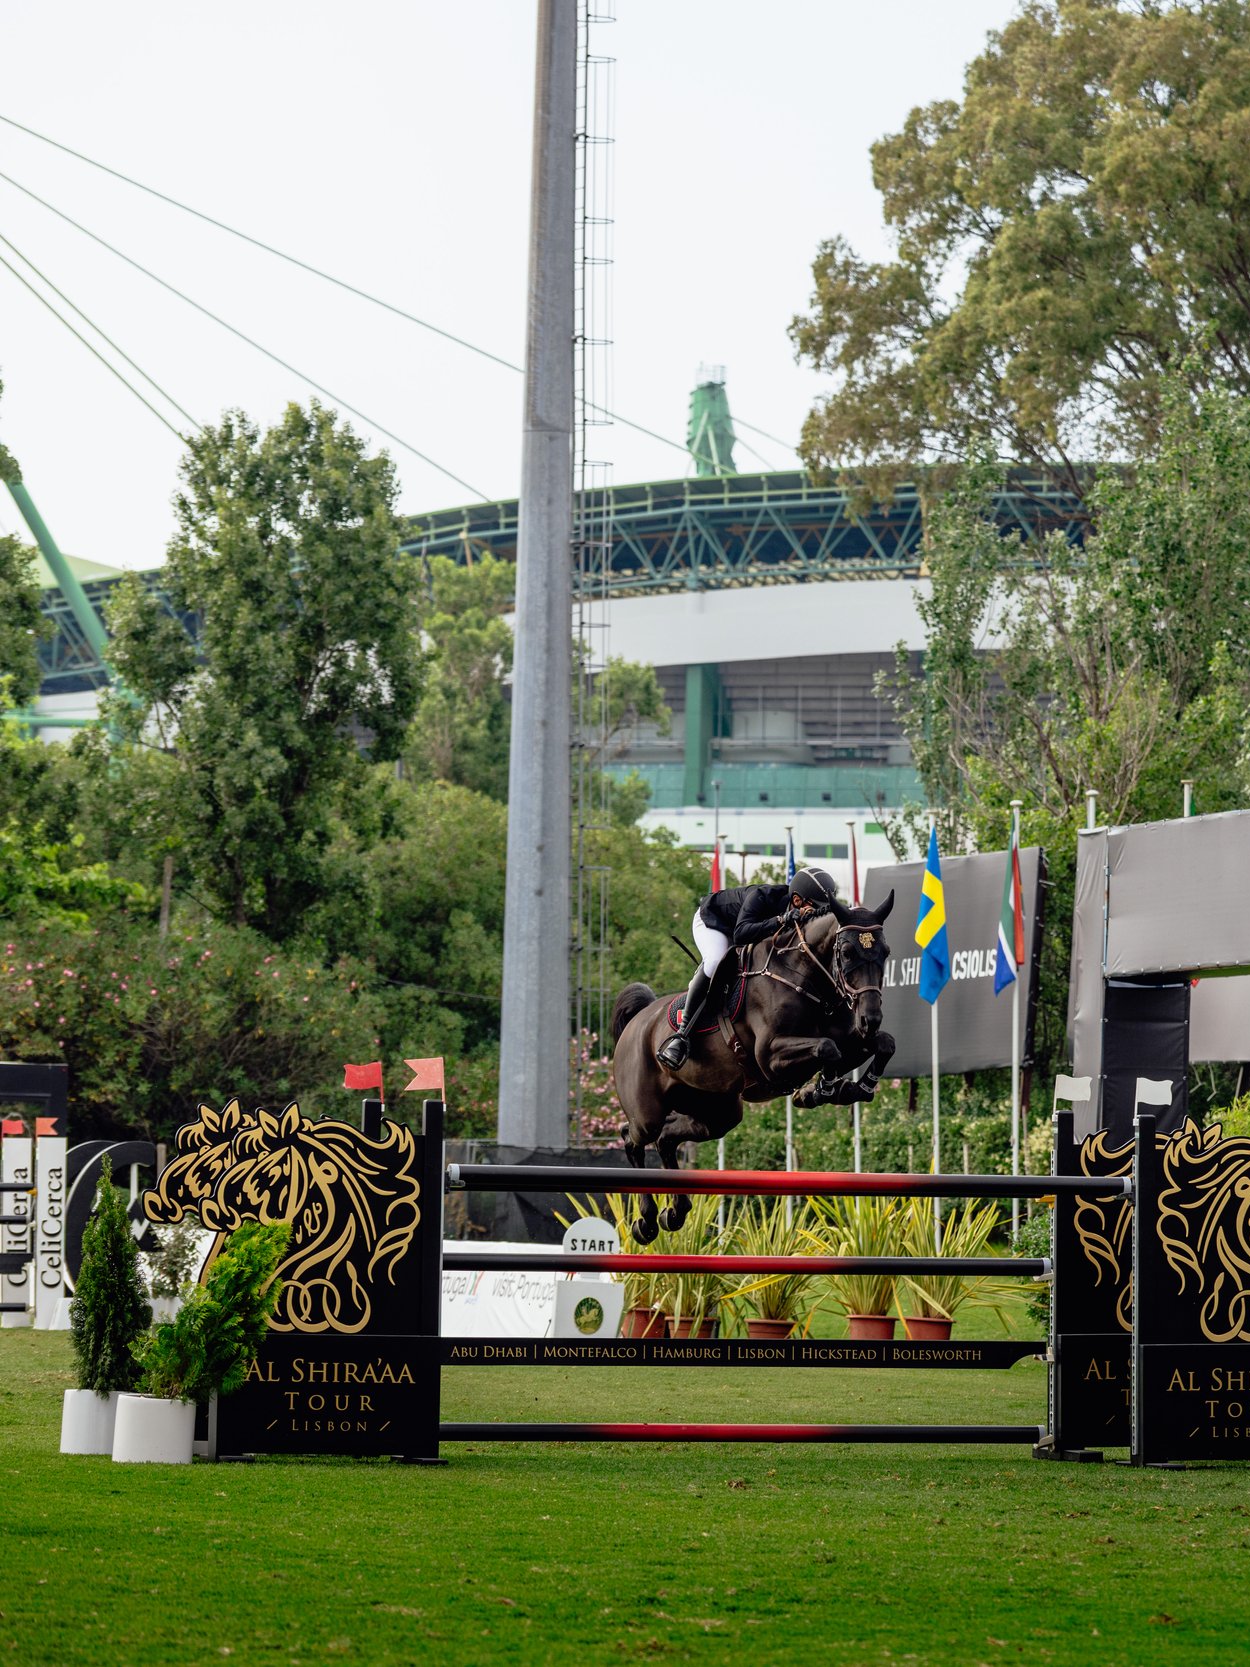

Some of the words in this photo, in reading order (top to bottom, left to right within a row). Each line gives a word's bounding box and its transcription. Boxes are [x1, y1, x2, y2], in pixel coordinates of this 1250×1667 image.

[883, 960, 896, 987] AL
[952, 948, 998, 980] CSIOLIS
[7, 1167, 28, 1287] CliCera
[40, 1167, 62, 1289] CeliCerca
[571, 1238, 614, 1252] START
[516, 1274, 555, 1309] Portuga
[451, 1345, 479, 1358] ABU
[484, 1345, 527, 1358] DHABI
[543, 1346, 637, 1359] MONTEFALCO
[653, 1346, 721, 1359] HAMBURG
[738, 1347, 785, 1360] LISBON
[802, 1347, 876, 1361] HICKSTEAD
[893, 1348, 982, 1361] BOLESWORTH
[244, 1358, 281, 1383] AL
[291, 1357, 416, 1384] SHIRA'AA
[1083, 1357, 1117, 1380] AL
[1166, 1368, 1200, 1391] AL
[284, 1391, 375, 1412] TOUR
[292, 1419, 368, 1432] LISBON
